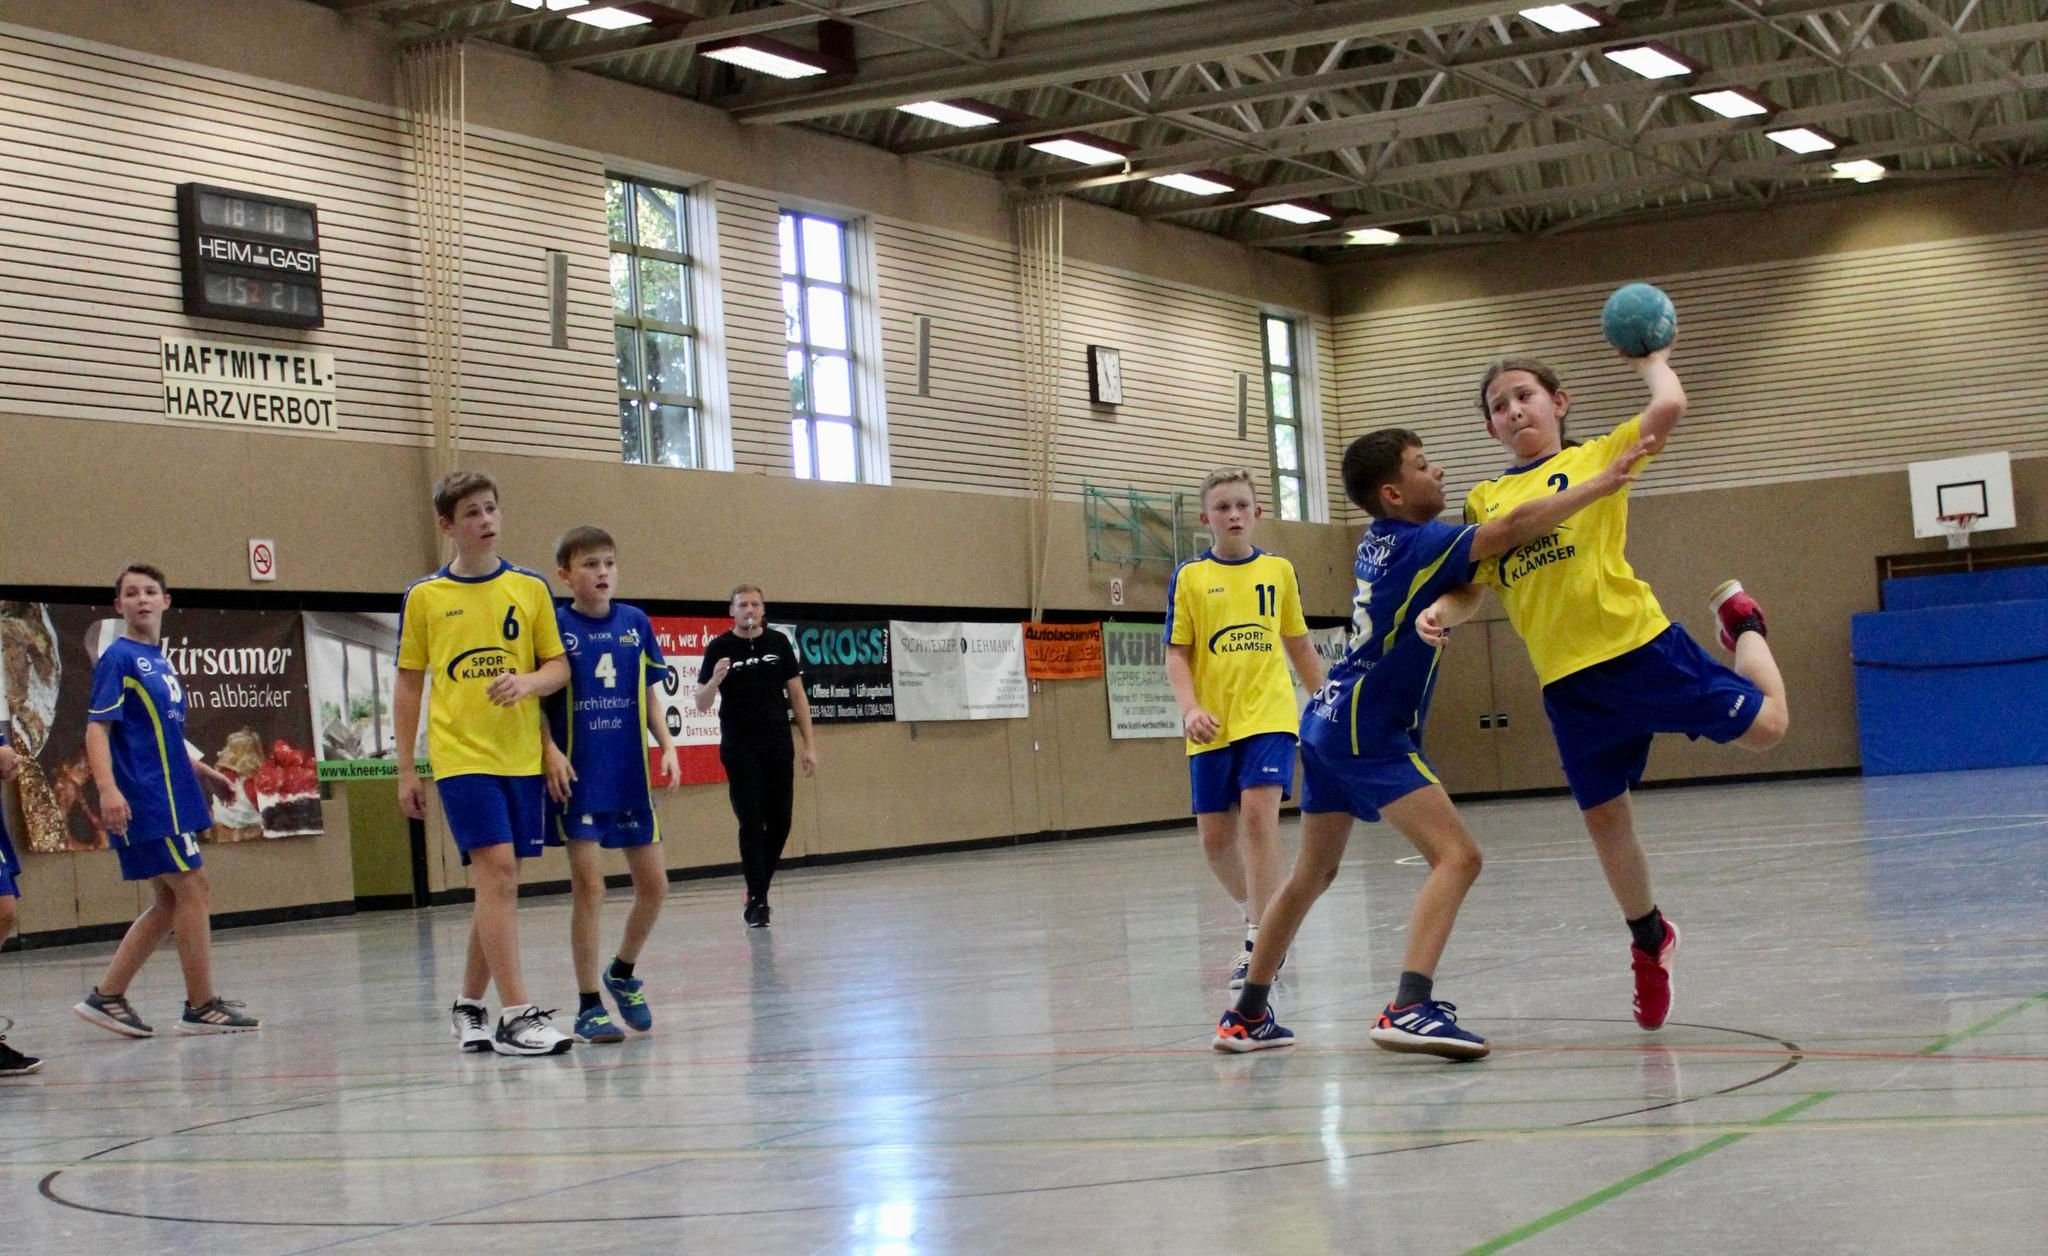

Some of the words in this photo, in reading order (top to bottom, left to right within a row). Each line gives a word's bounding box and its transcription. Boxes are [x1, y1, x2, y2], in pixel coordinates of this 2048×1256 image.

[198, 236, 251, 263] HEIM
[270, 248, 320, 273] GAST
[165, 385, 333, 427] HARZVERBOT
[1511, 545, 1576, 582] KLAMSER
[1516, 533, 1560, 562] SPORT
[1255, 583, 1275, 617] 11
[503, 605, 520, 641] 6
[1230, 631, 1264, 641] SPORT
[161, 636, 292, 676] kirsamer
[801, 628, 883, 666] GROSS
[1221, 642, 1273, 653] KLAMSER
[594, 652, 617, 688] 4
[210, 684, 292, 709] albbäcker
